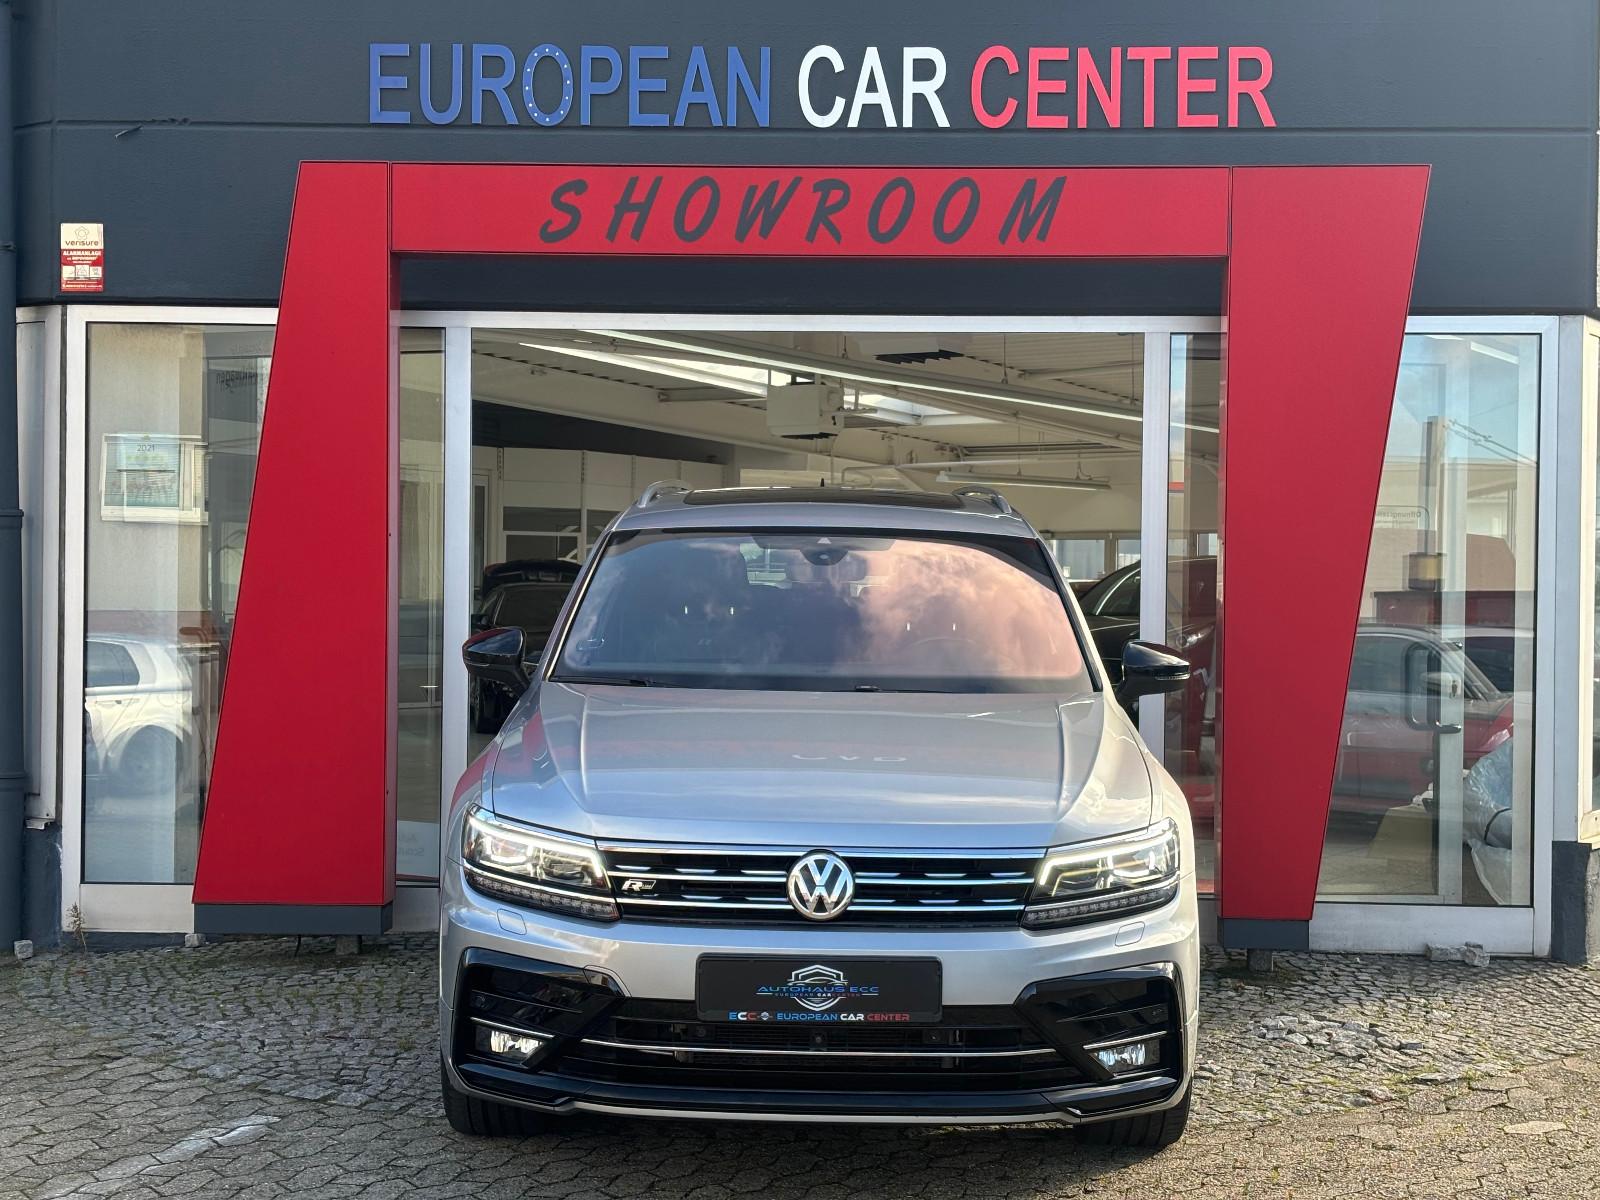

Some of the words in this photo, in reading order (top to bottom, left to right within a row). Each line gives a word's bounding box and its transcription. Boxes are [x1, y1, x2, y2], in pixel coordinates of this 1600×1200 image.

[369, 43, 771, 127] EUROPEAN
[798, 45, 950, 128] CAR
[971, 45, 1277, 128] CENTER
[539, 176, 1066, 245] SHOWROOM
[136, 444, 155, 452] 2021
[729, 1011, 756, 1021] ECC
[776, 1012, 838, 1021] EUROPEAN
[840, 1013, 865, 1021] CAR
[867, 1013, 911, 1021] CENTER
